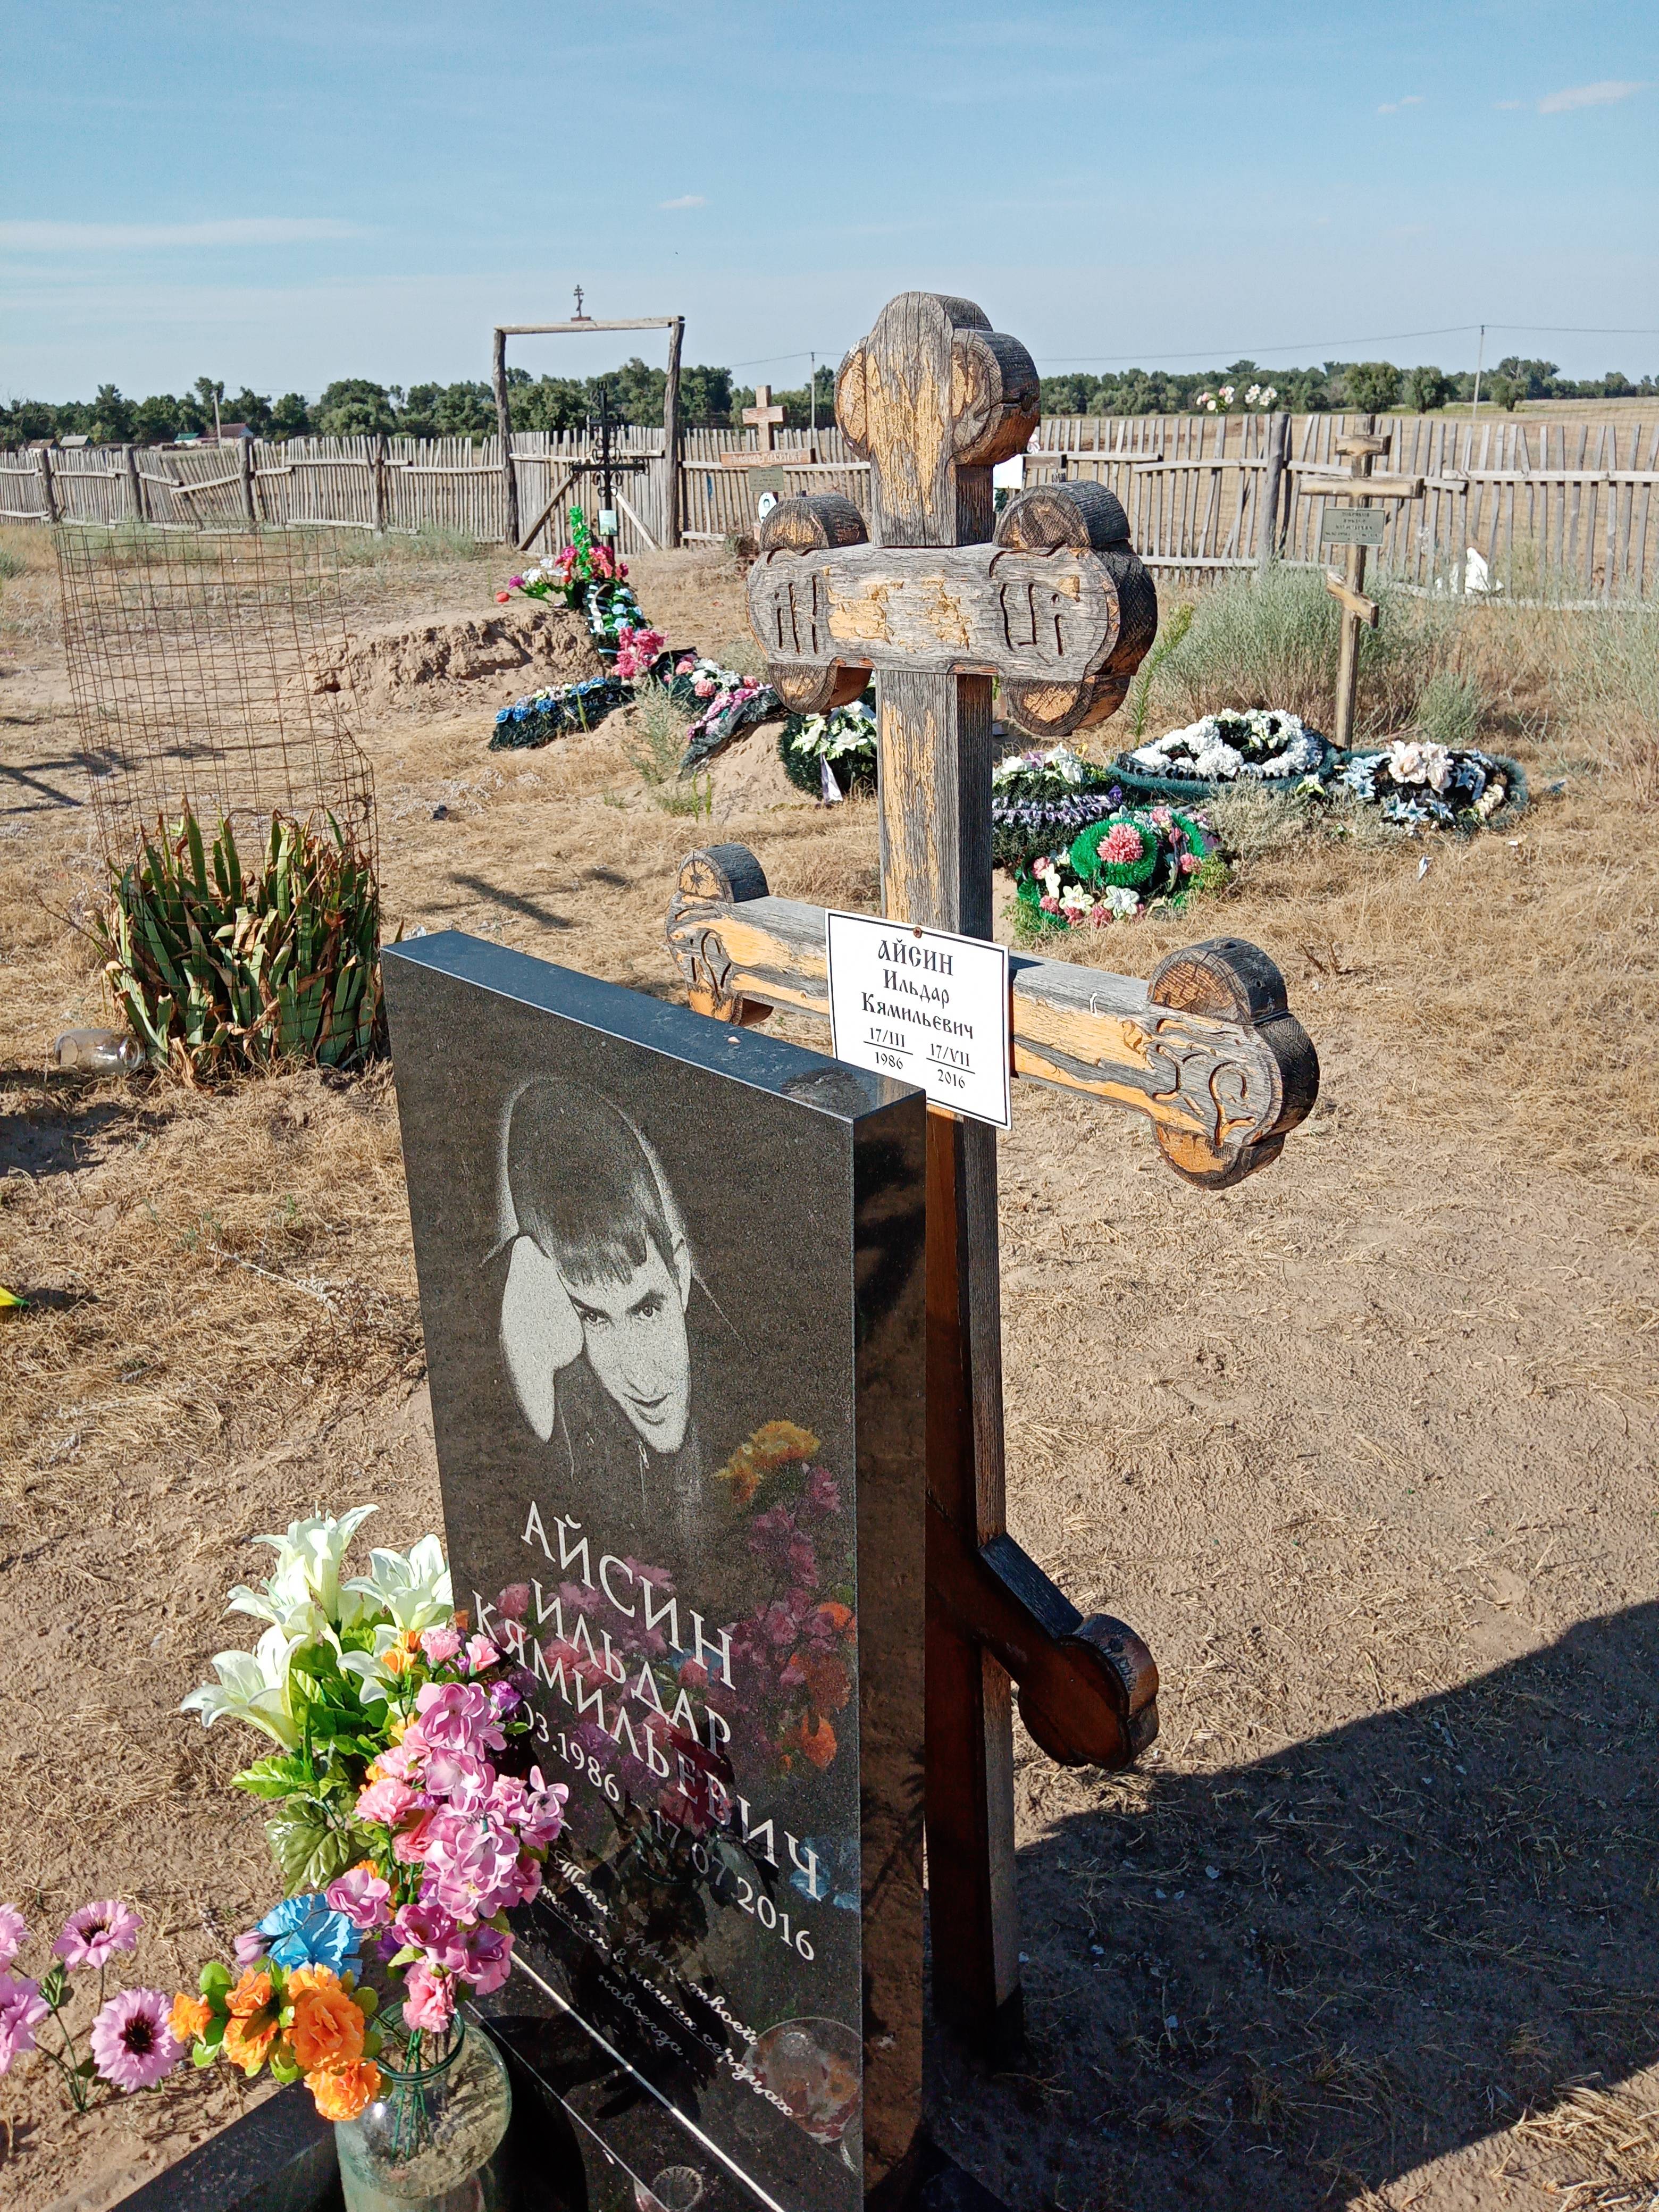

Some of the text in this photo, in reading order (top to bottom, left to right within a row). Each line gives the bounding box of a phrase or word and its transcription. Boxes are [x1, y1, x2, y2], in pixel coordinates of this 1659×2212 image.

[878, 938, 953, 976] АЙСИН
[883, 969, 950, 1009] Ильдар
[861, 992, 974, 1040] Кямильевич
[869, 1027, 970, 1067] 17/III 17/VII
[875, 1051, 966, 1089] 1986 2016
[521, 1499, 736, 1691] АЙСИН
[531, 1578, 731, 1759] ИЛЬДАР
[472, 1589, 822, 1903] КЯМИЛЬЕВИЧ
[539, 1885, 793, 2116] талось в наших сердцах
[549, 1849, 621, 1924] Тепло
[689, 1982, 758, 2046] твоей
